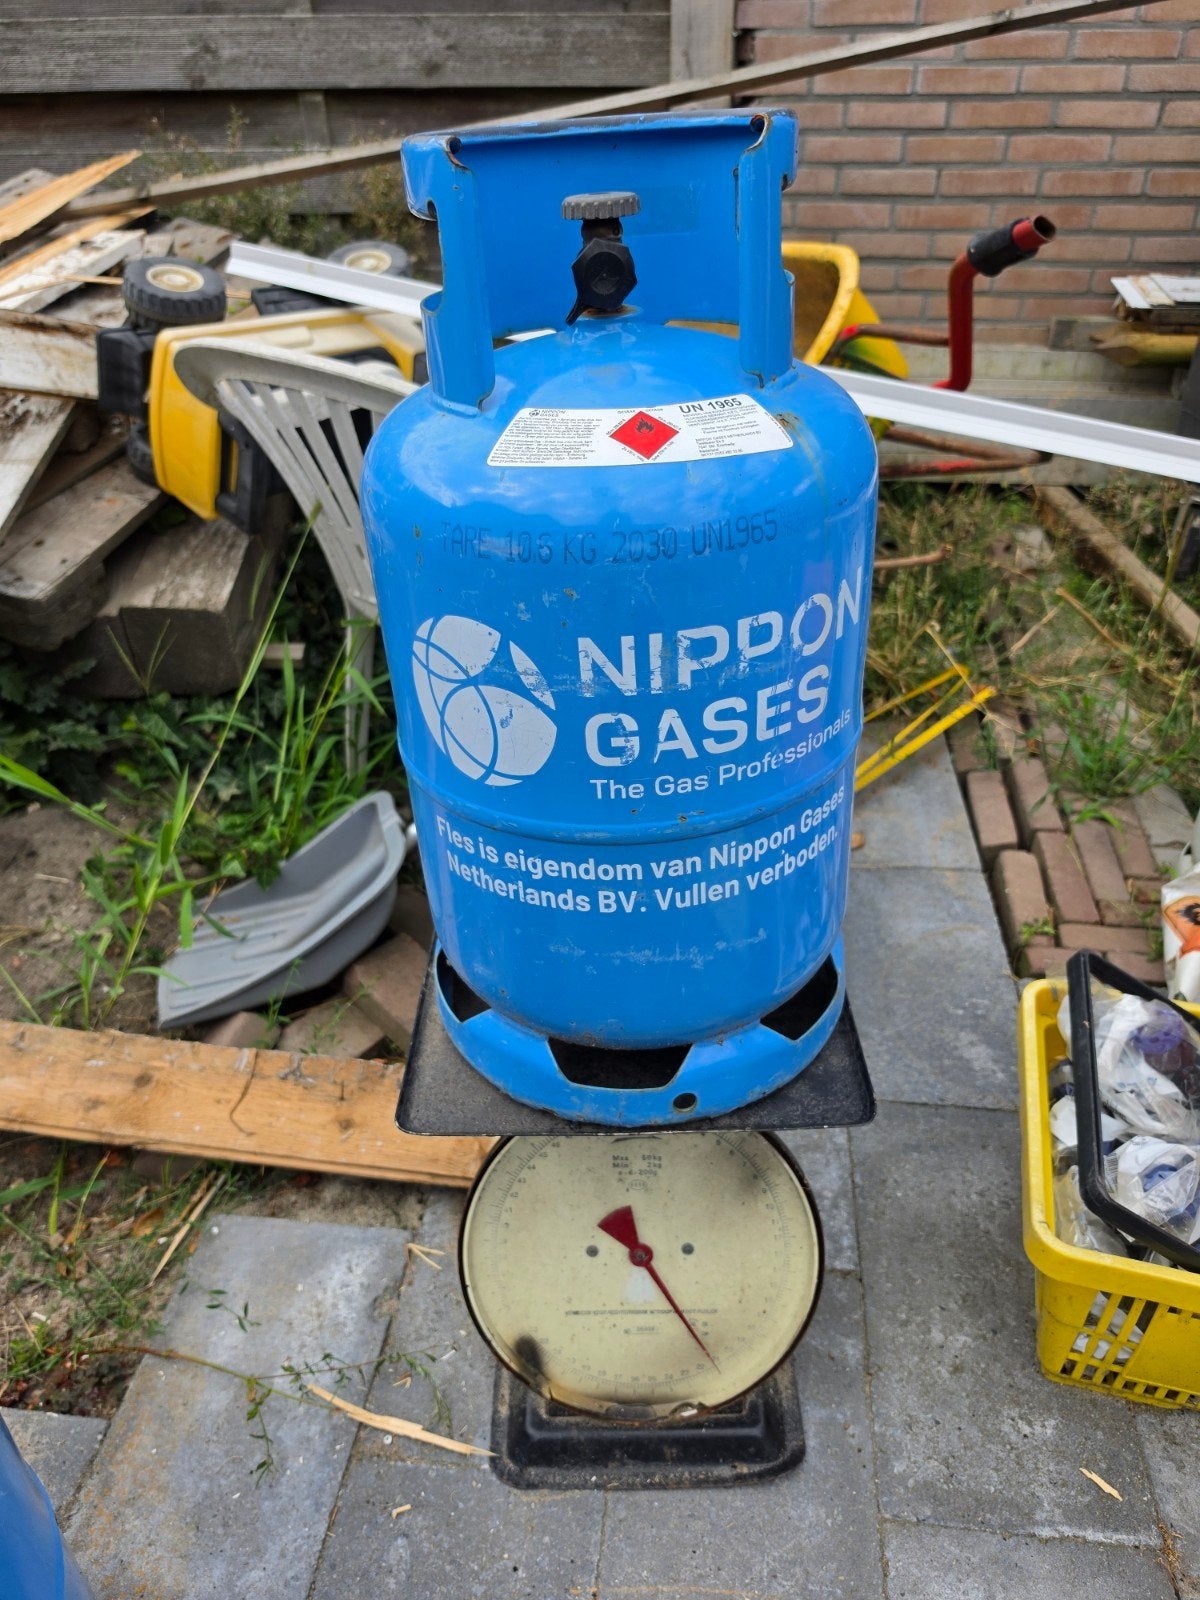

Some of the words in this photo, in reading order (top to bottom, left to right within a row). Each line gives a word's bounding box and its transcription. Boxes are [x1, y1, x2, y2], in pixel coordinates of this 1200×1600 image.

[679, 403, 704, 414] UN
[707, 397, 742, 410] 1965
[441, 521, 491, 560] TARE
[563, 530, 597, 565] KG
[611, 527, 679, 564] 2030
[691, 509, 778, 557] UN1965
[577, 565, 862, 697] NIPPON
[584, 664, 830, 767] GASES
[589, 779, 644, 800] The
[654, 772, 709, 796] Gas
[718, 709, 850, 785] Professionals
[436, 814, 475, 855] Fles
[479, 838, 499, 864] is
[504, 848, 644, 882] eigendom
[649, 857, 702, 879] van
[709, 822, 796, 869] Nippon
[799, 785, 845, 835] Gases
[447, 851, 590, 913] Netherlands
[597, 890, 647, 914] BV.
[656, 868, 740, 911] Vullen
[746, 825, 839, 889] verboden.
